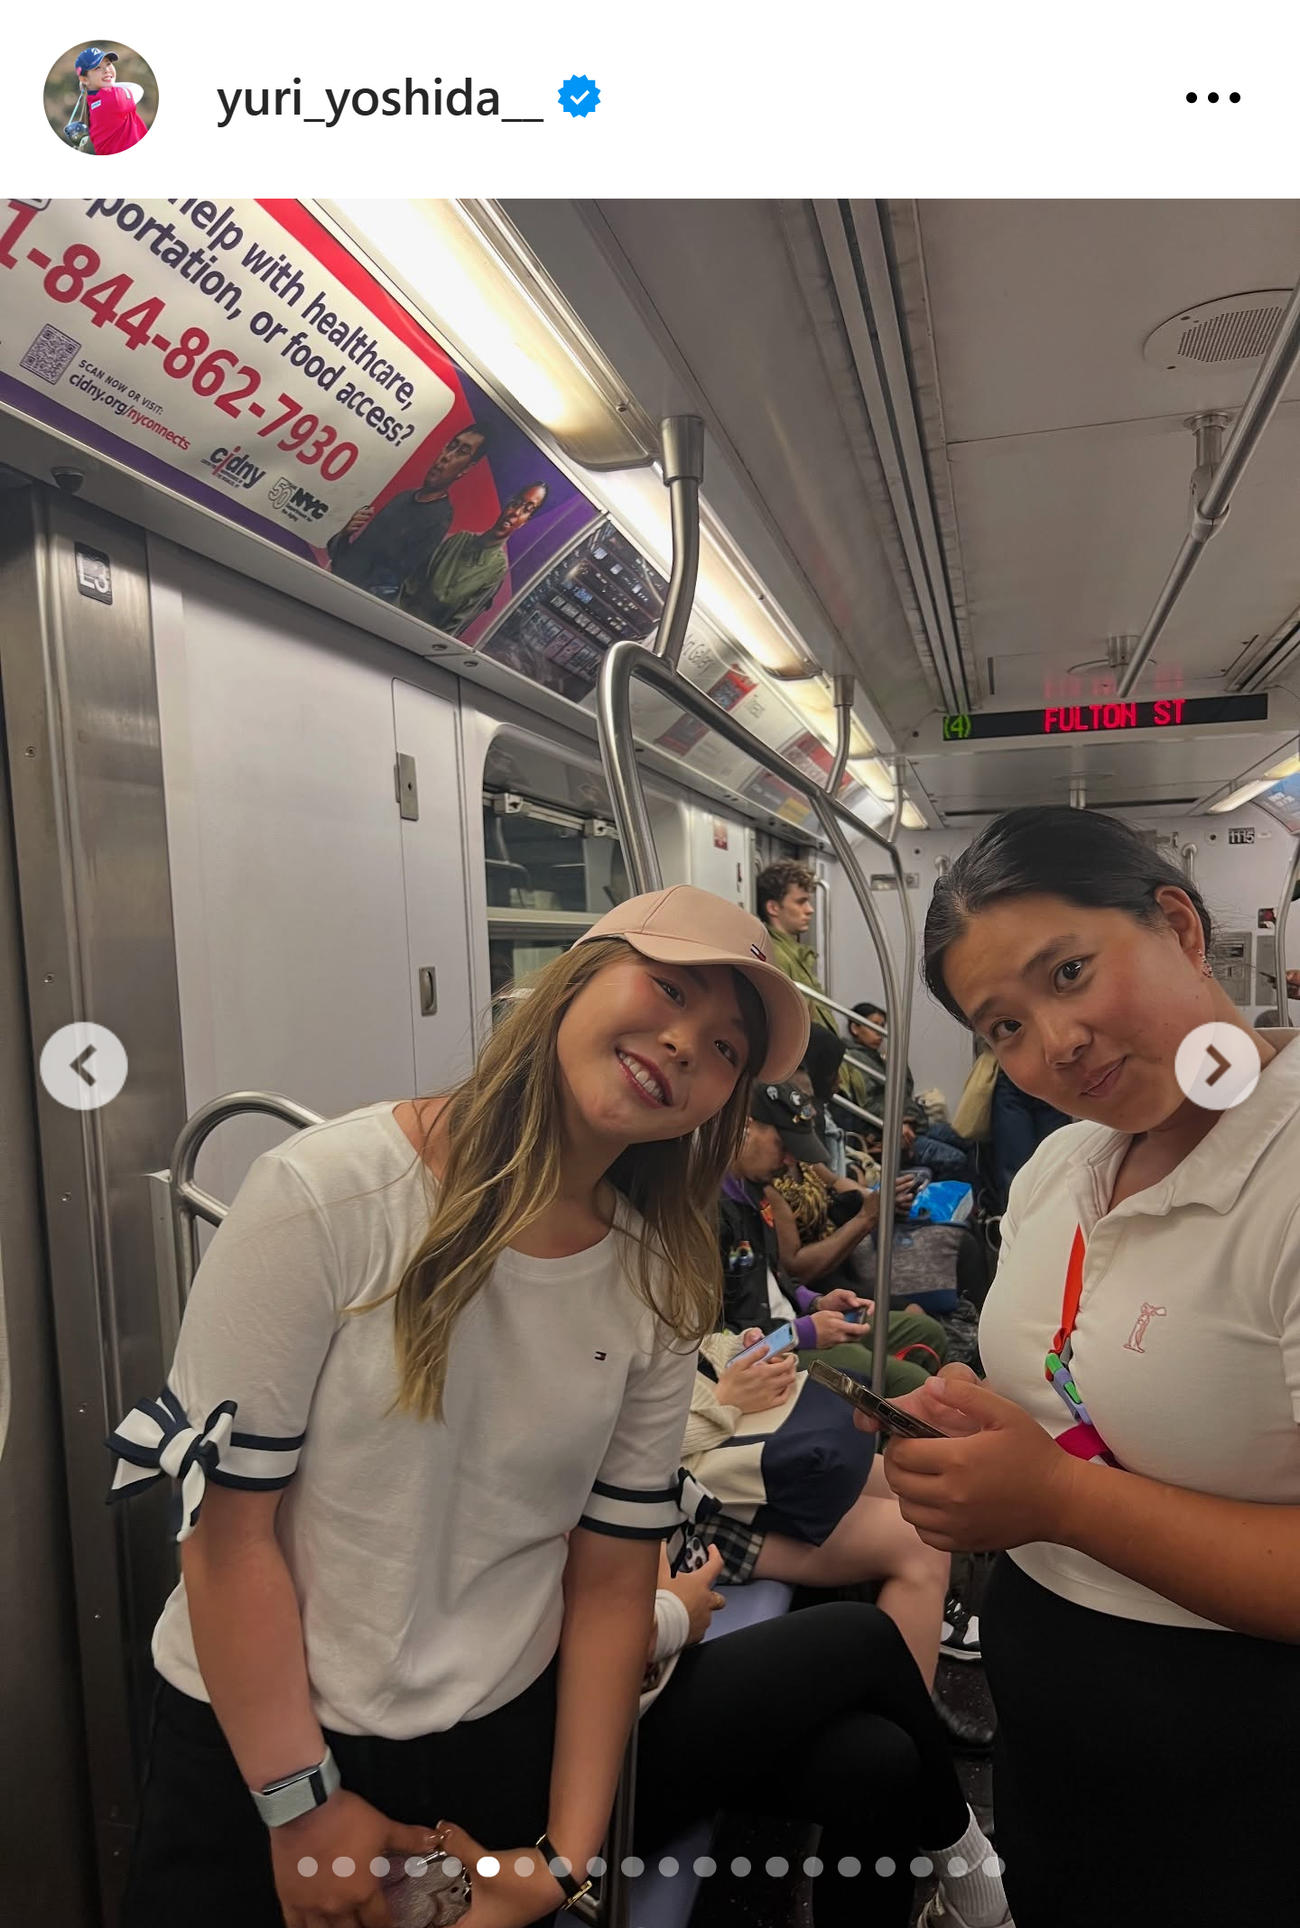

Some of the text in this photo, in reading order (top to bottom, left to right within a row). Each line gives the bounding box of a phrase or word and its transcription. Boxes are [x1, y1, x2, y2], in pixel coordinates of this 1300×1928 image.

[0, 202, 359, 481] 1-844-862-7930
[84, 199, 415, 447] portation, or food access?
[241, 242, 305, 307] with
[301, 291, 415, 411] healthcare,
[69, 373, 191, 451] cidny.org/nyconnects
[78, 359, 164, 415] SCAN NOW OR VISIT:
[210, 446, 266, 489] cidny
[290, 487, 329, 520] NYC
[1043, 702, 1136, 733] FULTON
[1153, 699, 1186, 725] ST
